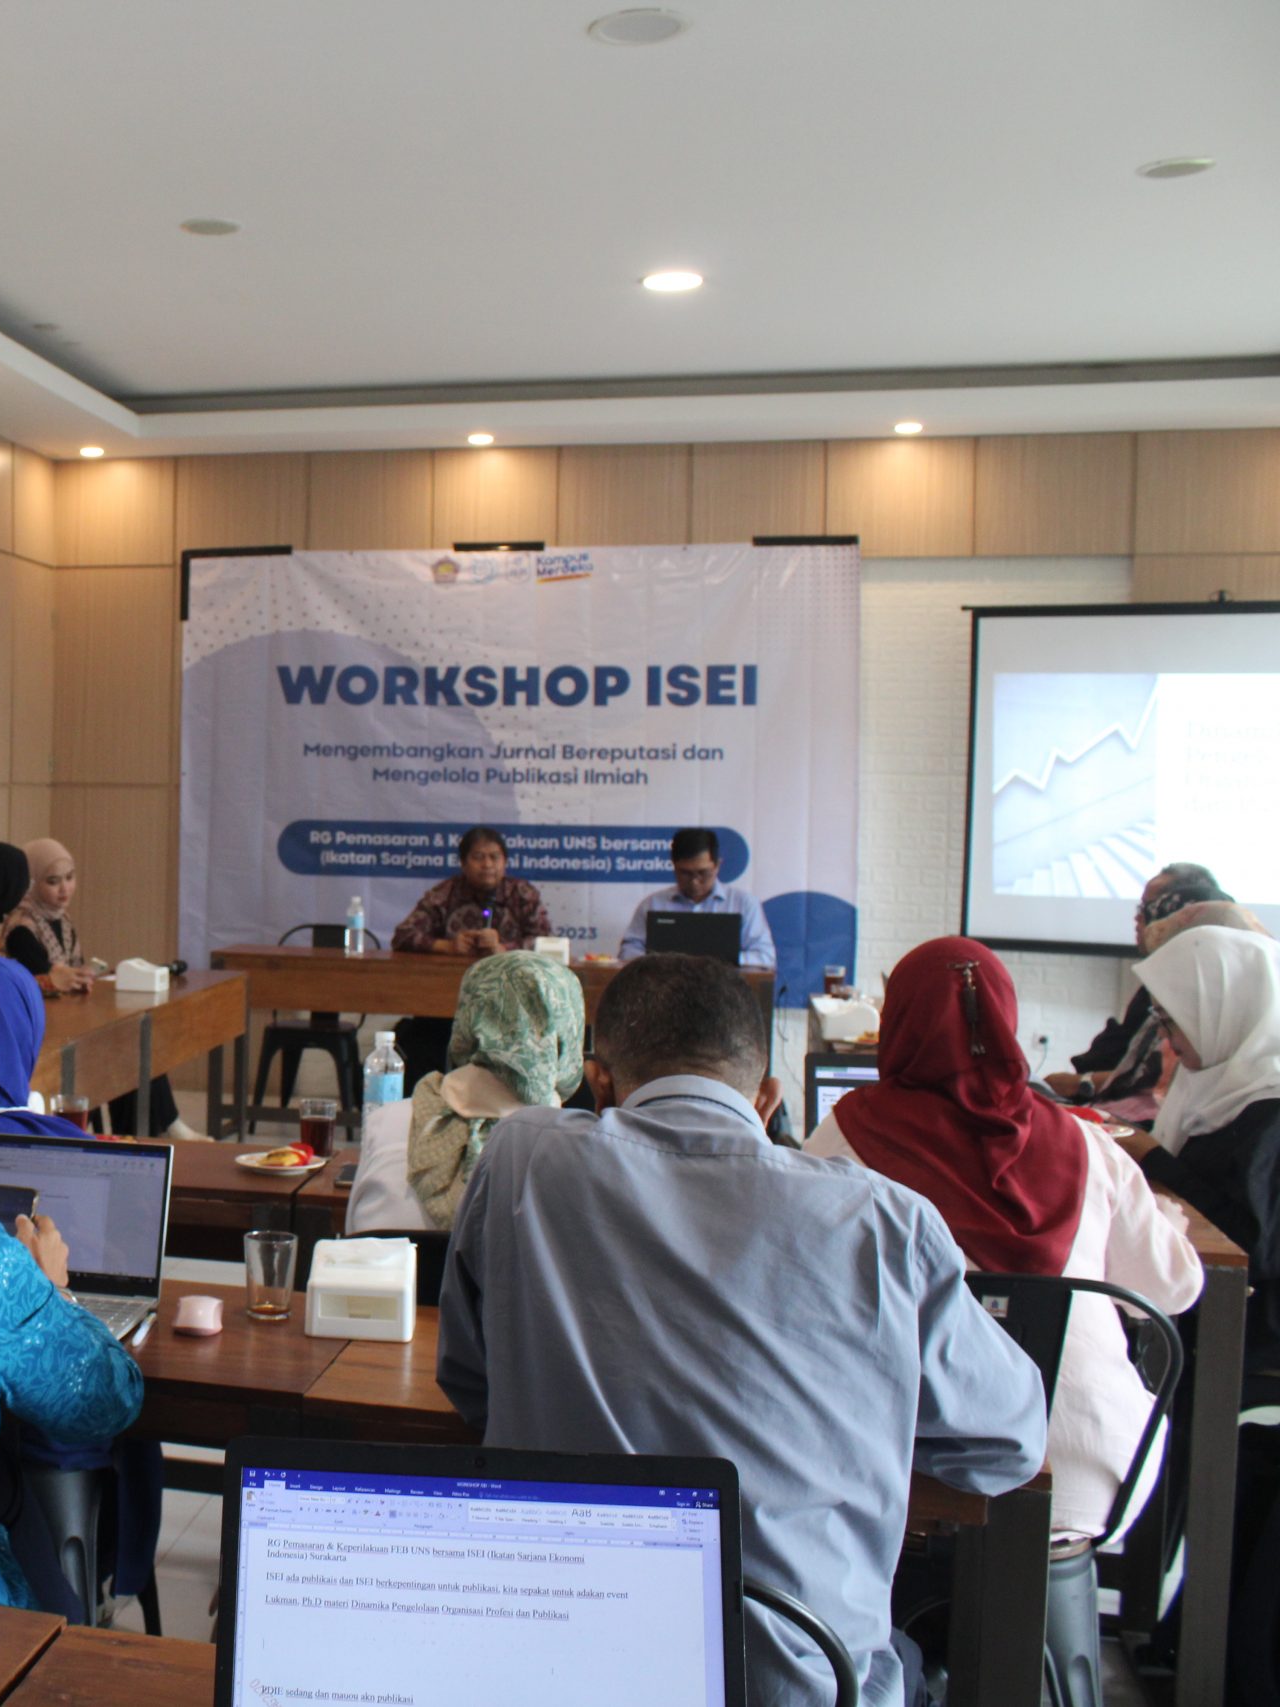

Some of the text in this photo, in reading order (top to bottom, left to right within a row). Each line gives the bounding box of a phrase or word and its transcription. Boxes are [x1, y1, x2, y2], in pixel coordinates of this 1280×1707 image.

[276, 664, 758, 707] WORKSHOP ISEI
[303, 742, 724, 764] Mengembangkan Jurnal Bereputasi dan
[372, 767, 648, 786] Mengelola Publikasi Ilmiah
[310, 831, 332, 844] RG
[336, 831, 429, 847] Pemasaran
[433, 833, 444, 847] &
[563, 835, 597, 851] UNS
[381, 853, 443, 869] Sarjana
[523, 856, 612, 872] Indonesia)
[616, 856, 676, 872] Suraka
[557, 926, 597, 940] 2023
[267, 1539, 585, 1563] RG Pemasaran & Keperilakuan FEB UNS bersama ISEI (Ikatan Sarjana Ekonomi
[267, 1550, 347, 1562] Indonesia) Surakarta
[266, 1572, 284, 1581] ISEI
[286, 1574, 300, 1582] ada
[339, 1576, 353, 1584] dan
[356, 1578, 374, 1586] ISEI
[376, 1578, 436, 1591] berkepentingan
[438, 1581, 460, 1590] untuk
[503, 1584, 518, 1593] kita
[520, 1585, 550, 1596] sepakat
[552, 1587, 575, 1597] untuk
[576, 1589, 605, 1599] adakan
[607, 1591, 629, 1599] event
[324, 1599, 349, 1608] materi
[351, 1600, 390, 1610] Dinamika
[391, 1602, 440, 1614] Pengelolaan
[441, 1604, 484, 1616] Organisasi
[486, 1607, 514, 1617] Profesi
[516, 1608, 530, 1617] dan
[532, 1609, 569, 1620] Publikasi
[285, 1688, 313, 1699] sedang
[315, 1690, 330, 1698] dan
[377, 1694, 414, 1704] publikasi
